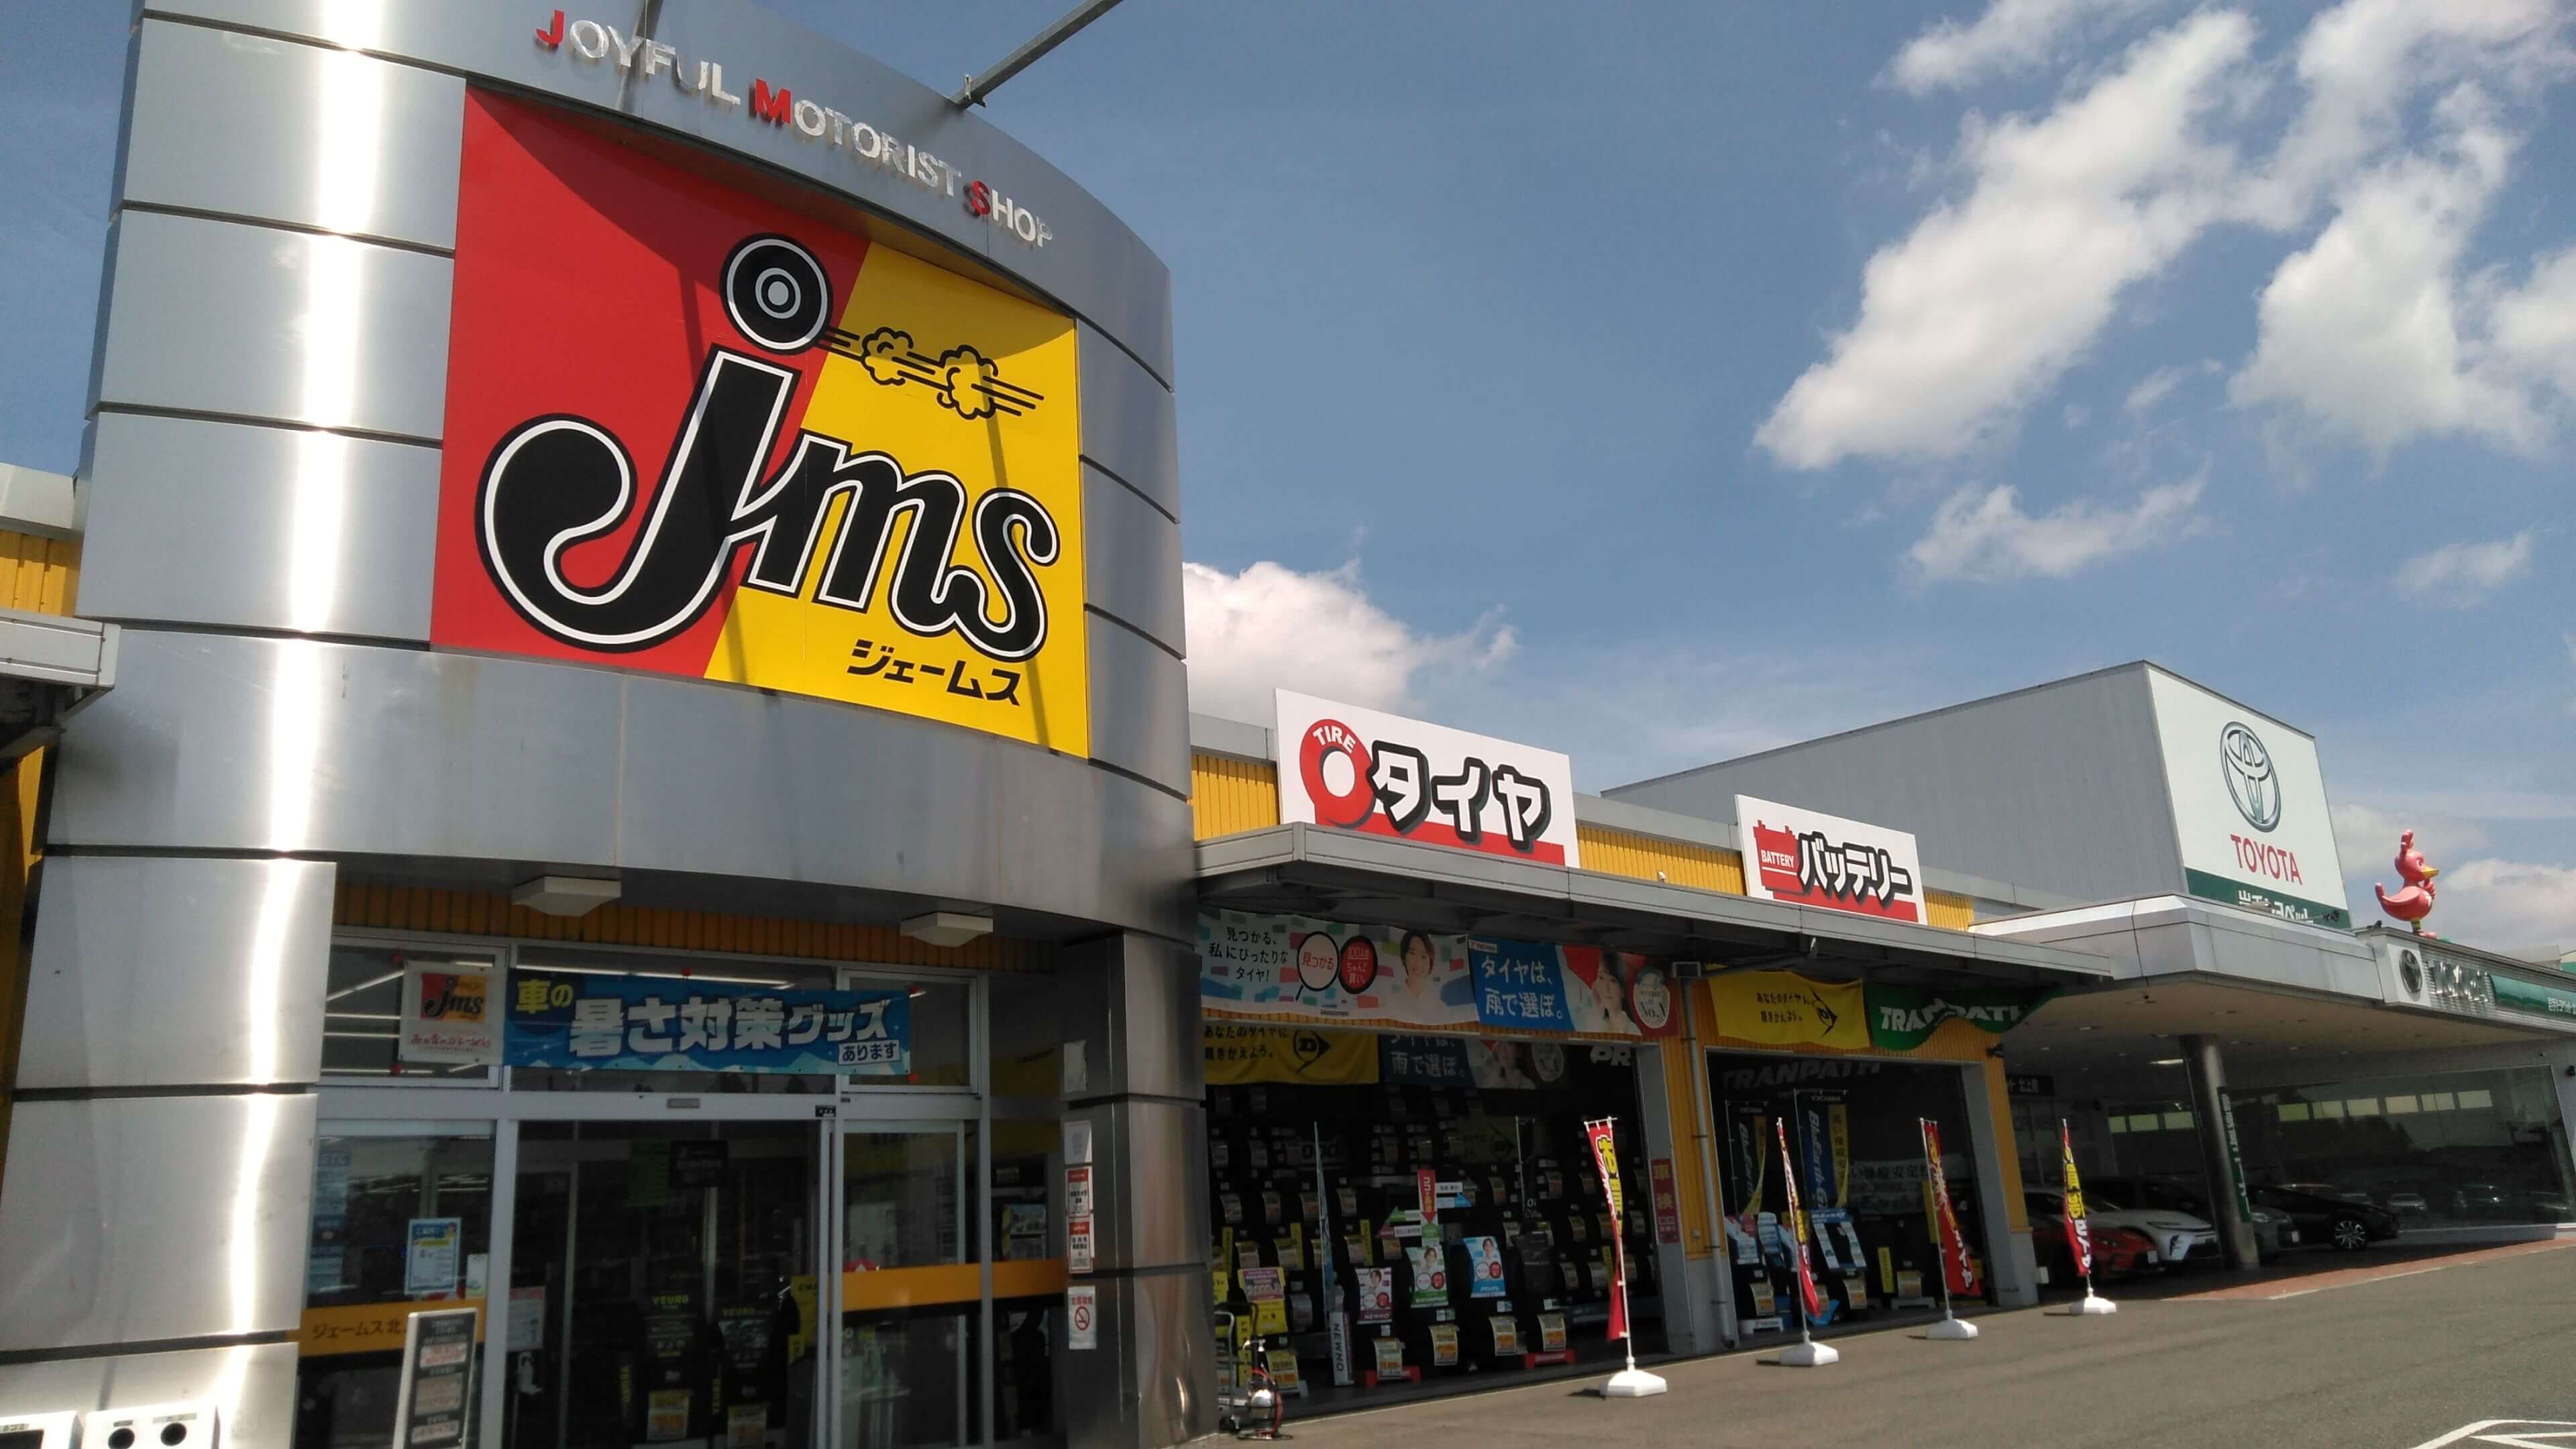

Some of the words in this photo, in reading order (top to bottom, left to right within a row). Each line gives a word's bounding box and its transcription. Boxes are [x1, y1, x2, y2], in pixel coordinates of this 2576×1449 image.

[535, 8, 741, 106] JOYFUL
[753, 78, 961, 197] MOTORIST
[966, 179, 1053, 249] SHOP
[847, 639, 1021, 706] ジェームス
[1312, 724, 1357, 754] TIRE
[1366, 741, 1552, 851] タイヤ
[1760, 848, 1794, 869] BATTERY
[1799, 831, 1913, 908] バッテリー
[2230, 834, 2303, 885] TOYOTA
[1208, 943, 1289, 969] 私にぴったりな
[1302, 951, 1334, 970] 見つかる
[1481, 955, 1553, 986] タイヤは、
[516, 980, 573, 1014] 車の
[1484, 987, 1563, 1020] 雨で選ぼ。
[570, 996, 888, 1058] 暑さ対策グッズ
[842, 1043, 898, 1063] あります
[312, 1319, 410, 1340] ジェームス北
[1333, 1323, 1344, 1373] NEWNO
